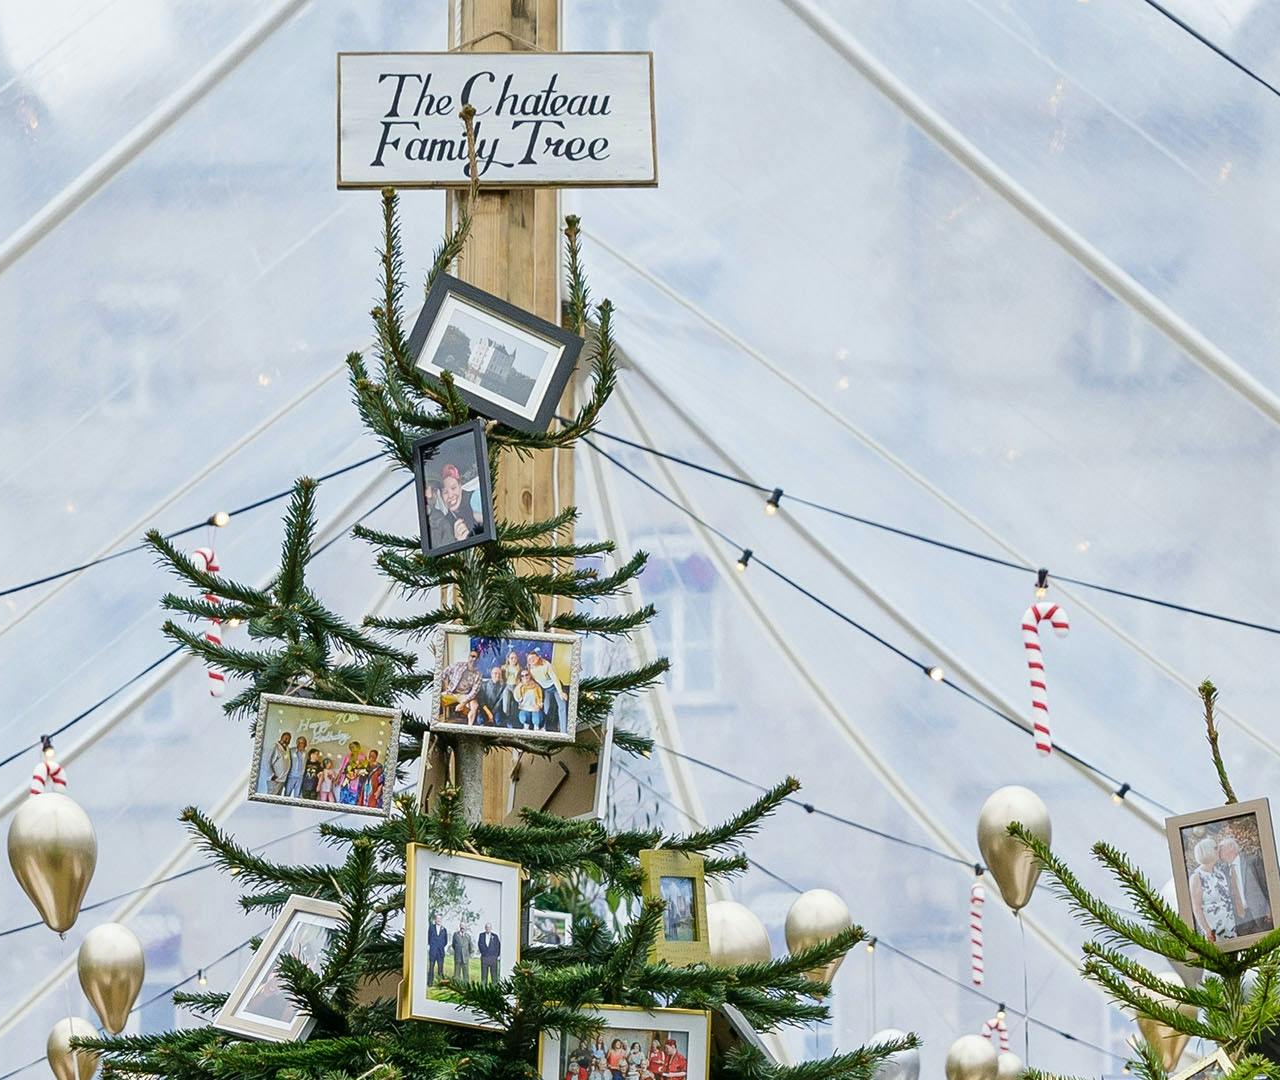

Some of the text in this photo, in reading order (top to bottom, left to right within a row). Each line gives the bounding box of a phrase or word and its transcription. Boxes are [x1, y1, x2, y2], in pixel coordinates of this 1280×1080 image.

[378, 71, 611, 118] The Chateau
[370, 119, 611, 178] Family Tree
